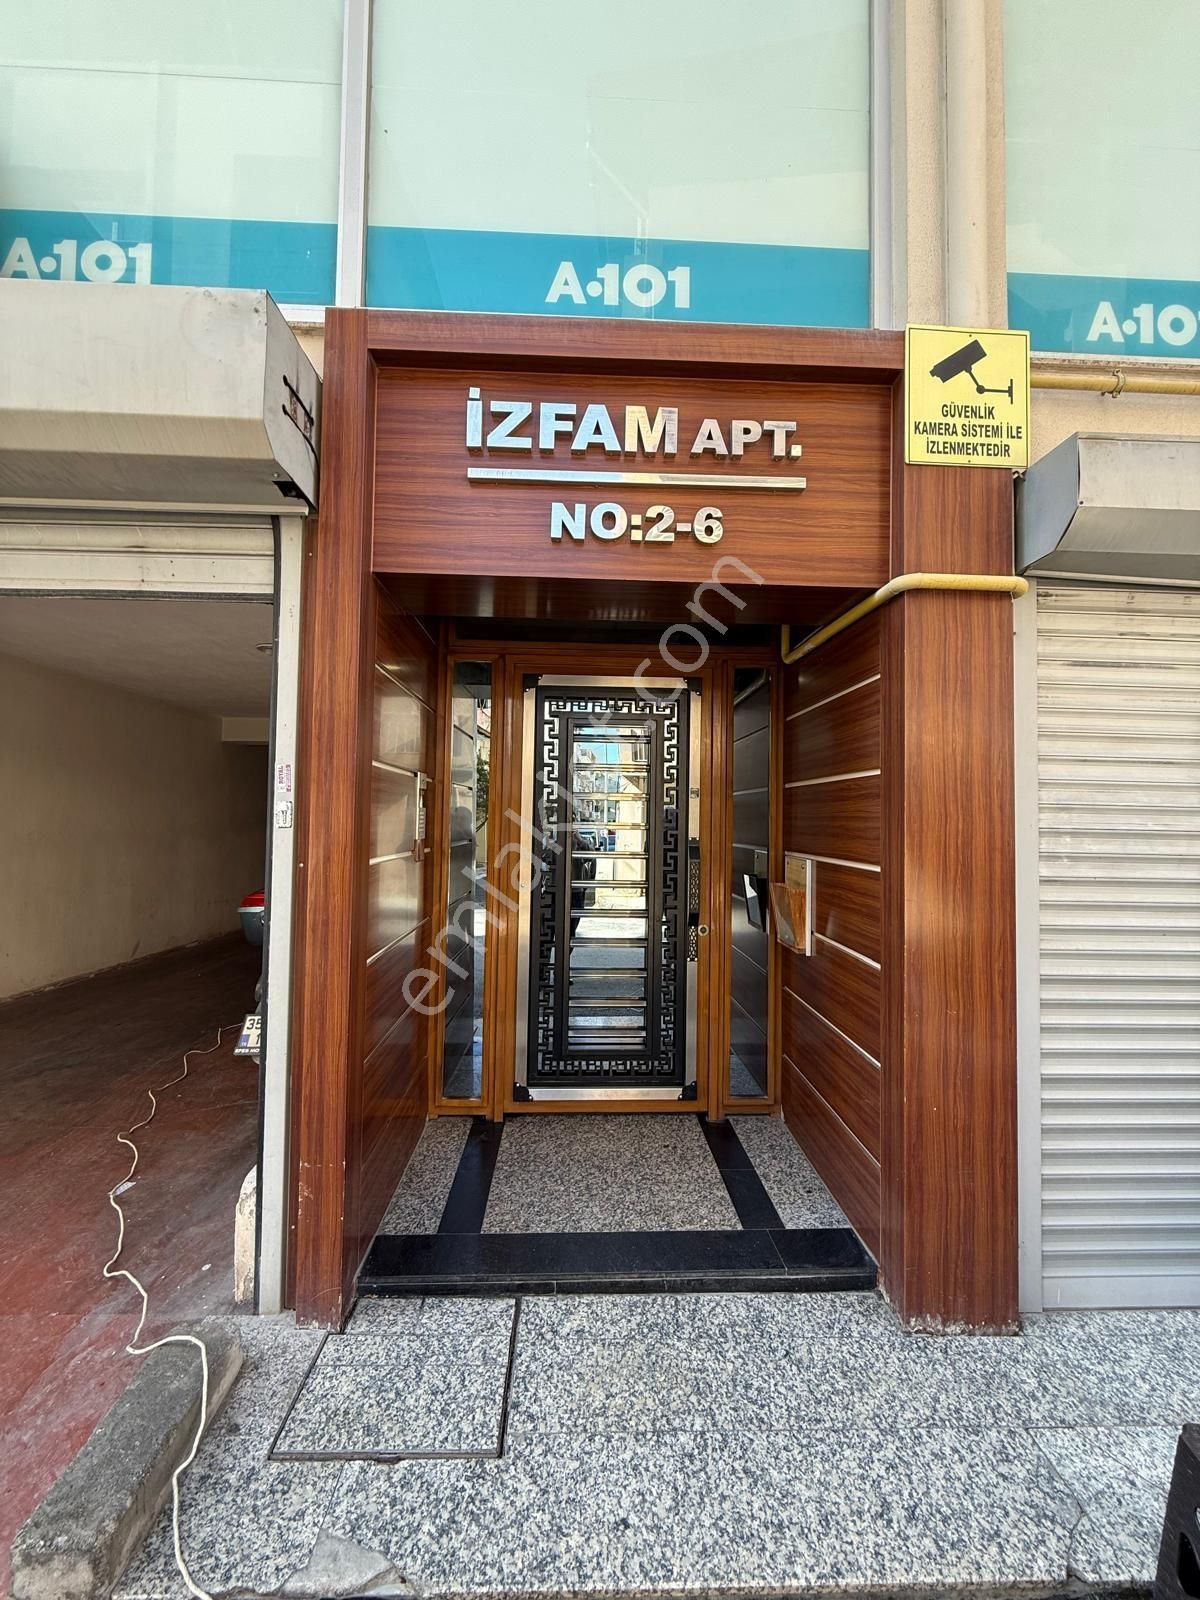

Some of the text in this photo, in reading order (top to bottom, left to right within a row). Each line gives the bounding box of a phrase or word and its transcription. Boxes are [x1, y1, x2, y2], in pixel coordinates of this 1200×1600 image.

[941, 401, 995, 420] GÜVENLİK
[466, 387, 802, 461] İZFAM APT.
[914, 420, 1022, 439] KAMERA SİSTEMİ İLE
[926, 437, 1010, 457] İZLENMEKTEDİR
[550, 502, 724, 545] NO:2-6
